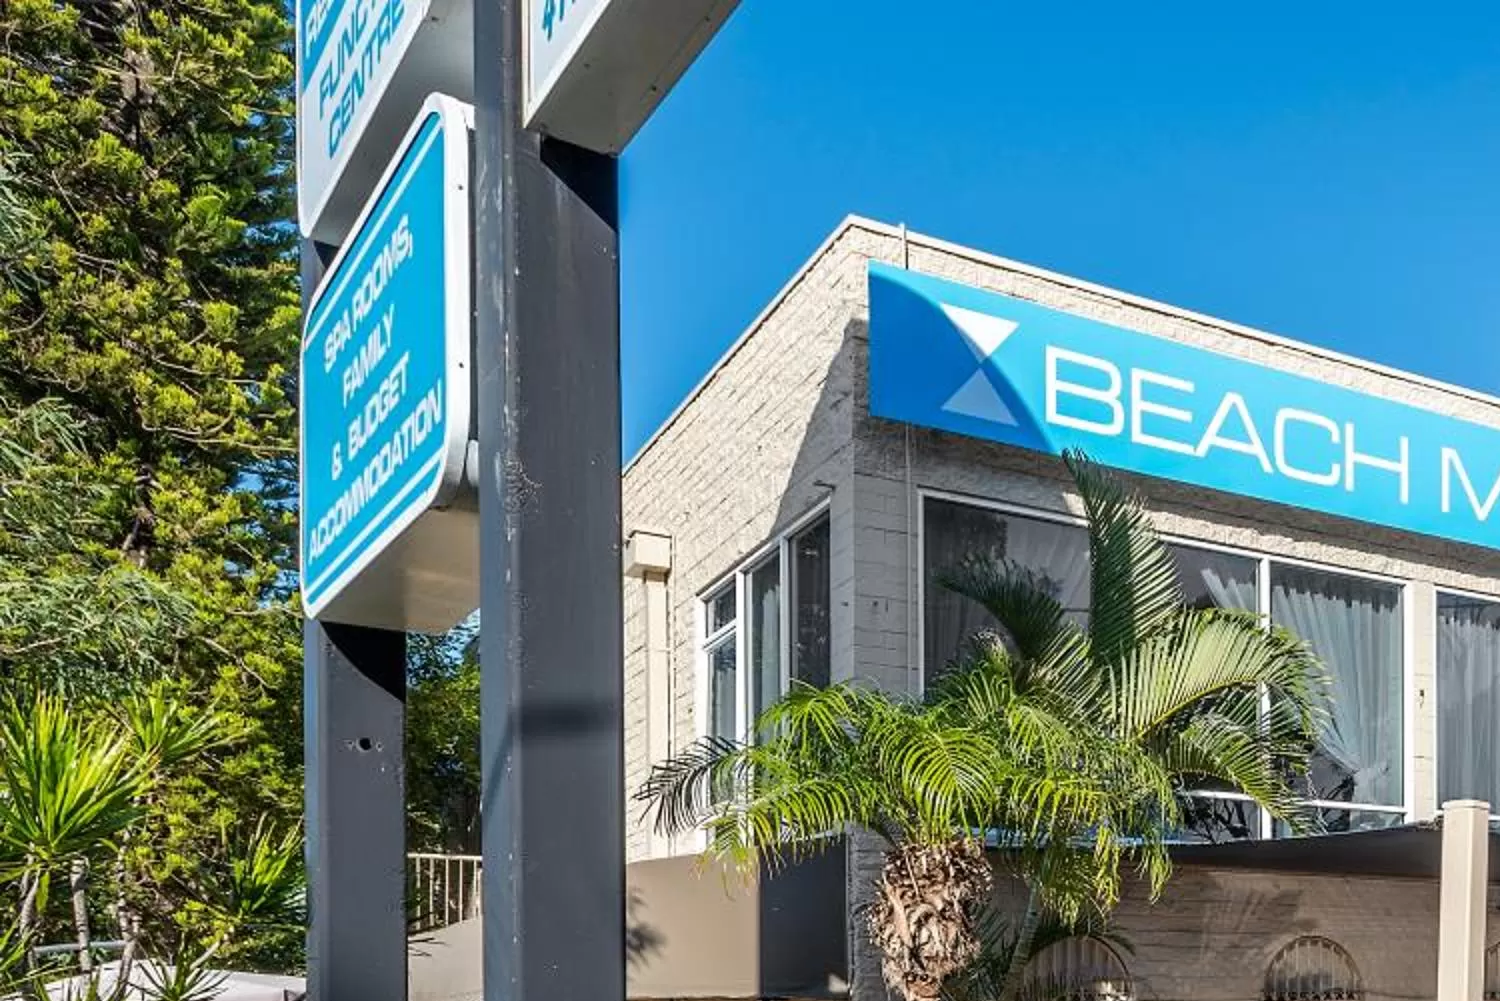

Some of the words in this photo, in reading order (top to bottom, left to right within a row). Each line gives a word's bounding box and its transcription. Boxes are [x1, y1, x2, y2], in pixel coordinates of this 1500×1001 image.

[324, 309, 351, 374] SPA
[352, 213, 413, 332] ROOMS,
[343, 303, 395, 409] FAMILY
[308, 377, 442, 566] ACCOMMODATION
[331, 439, 343, 481] &
[348, 351, 409, 461] BUDGET
[1045, 344, 1409, 505] BEACH
